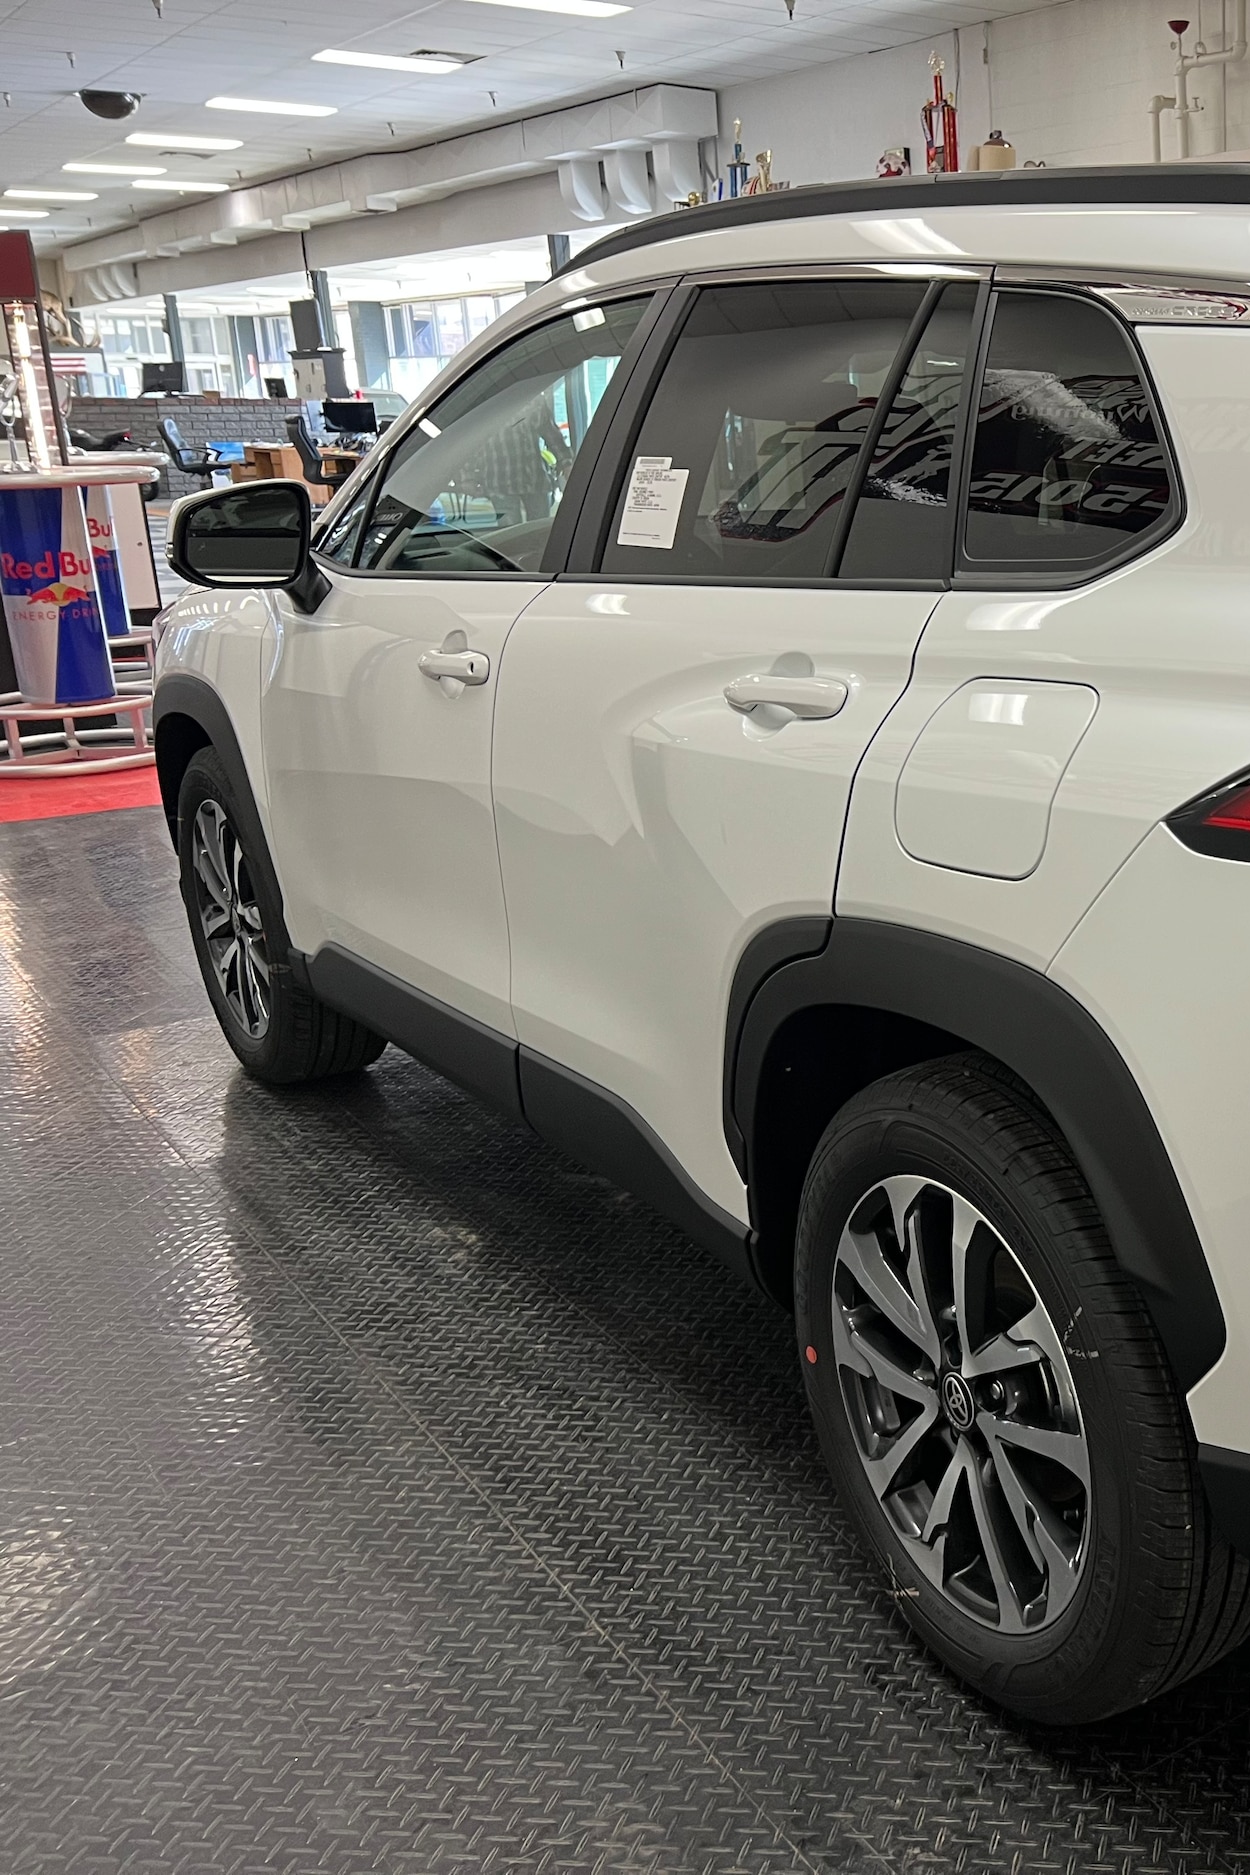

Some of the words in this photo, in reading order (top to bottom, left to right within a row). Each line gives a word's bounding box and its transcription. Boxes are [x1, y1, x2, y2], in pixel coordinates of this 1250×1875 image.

[1, 551, 56, 579] Red
[58, 551, 92, 577] Bu
[13, 610, 66, 621] ENERGY
